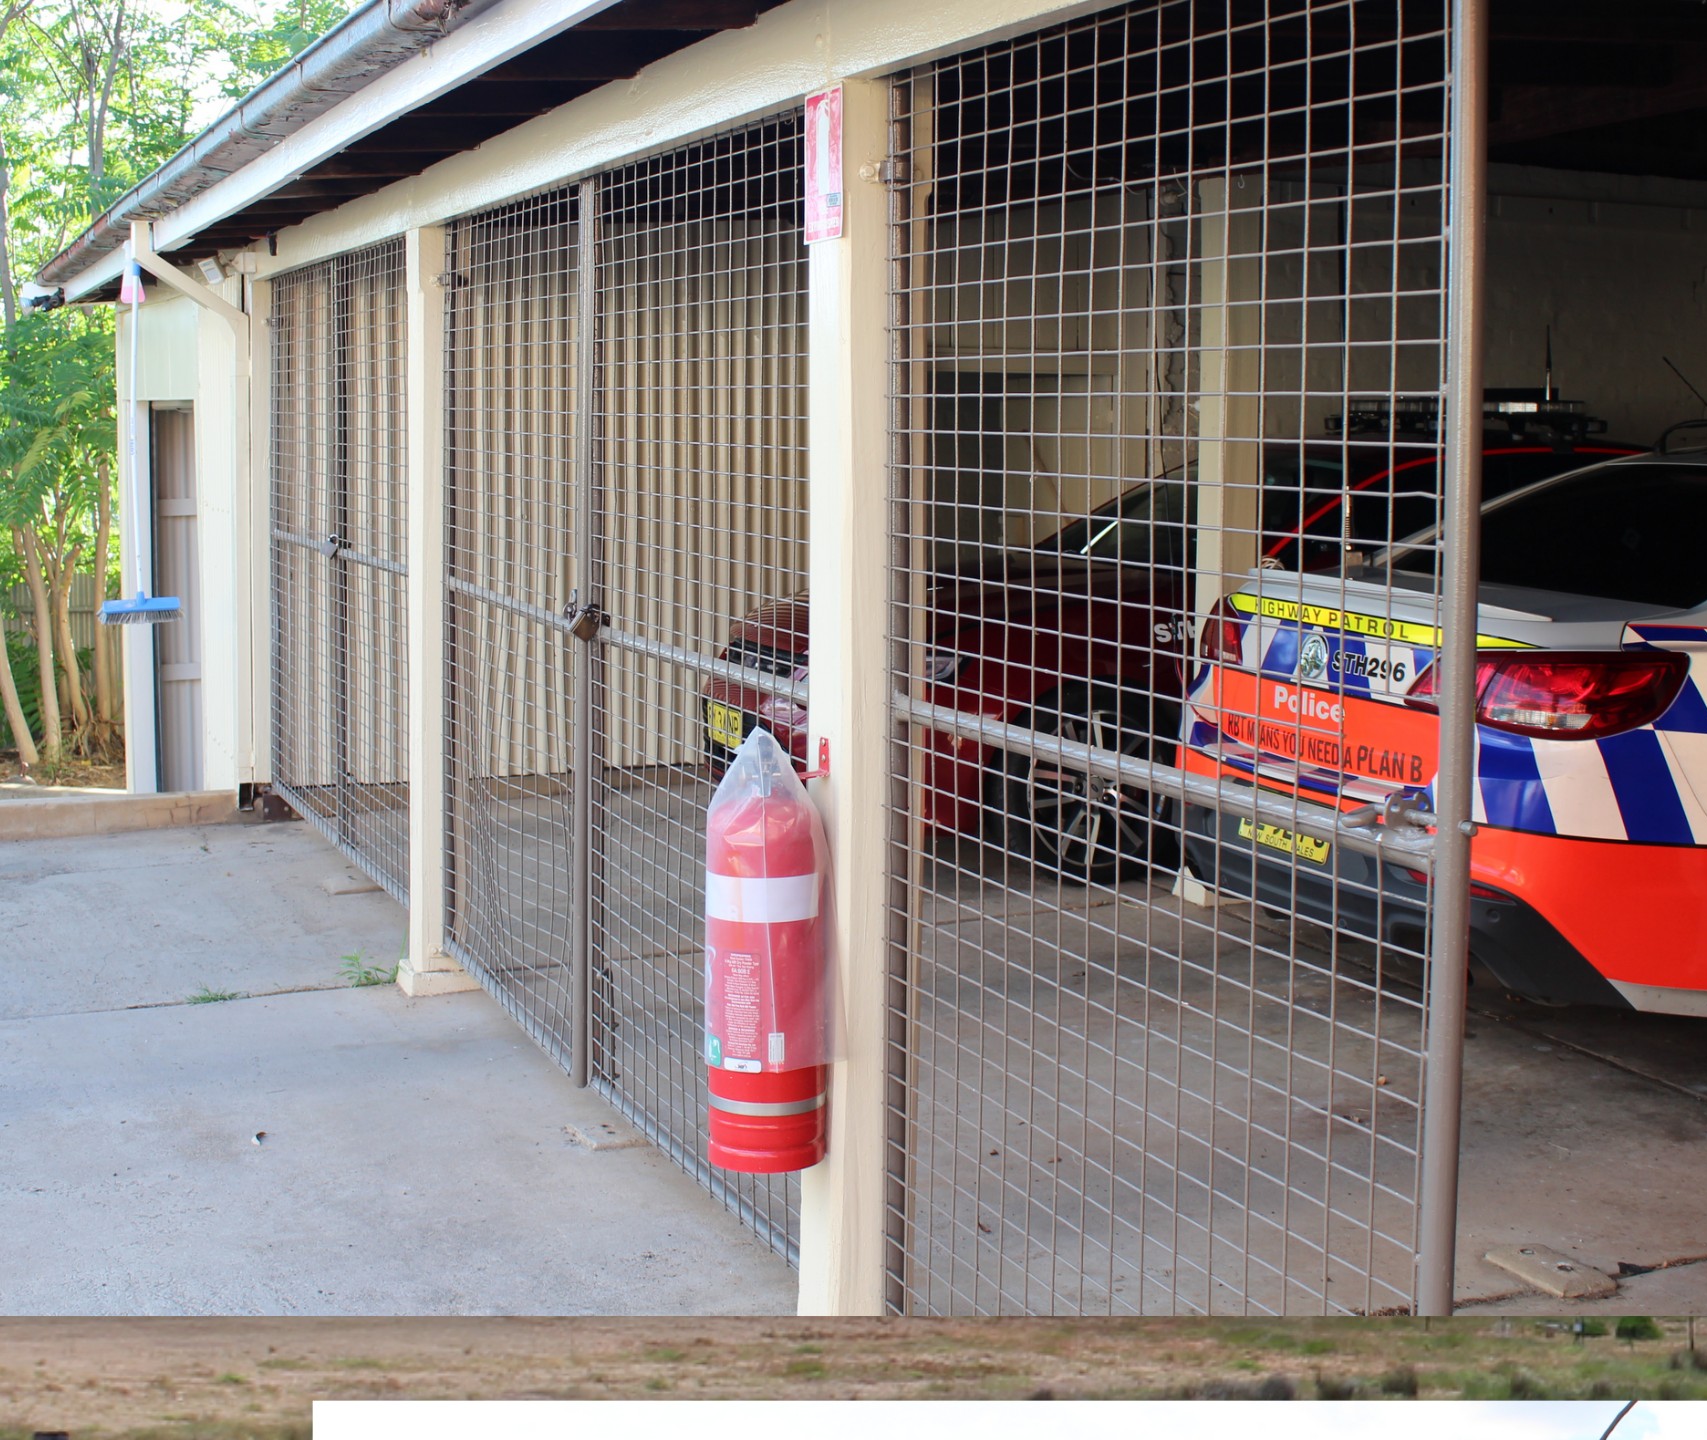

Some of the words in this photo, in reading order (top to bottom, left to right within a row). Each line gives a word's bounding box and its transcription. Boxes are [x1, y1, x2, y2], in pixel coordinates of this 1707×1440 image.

[1328, 612, 1409, 639] PATROL
[1332, 650, 1406, 682] STH296
[1274, 685, 1346, 723] Police
[1227, 712, 1247, 739] RBT
[1247, 719, 1280, 750] MANS
[1282, 729, 1305, 756] YOU
[1307, 738, 1341, 767] NEED
[1356, 745, 1405, 780] PLAN
[1410, 755, 1423, 783] B
[1248, 828, 1263, 841] NW
[1264, 834, 1288, 849] SOUTH
[1290, 842, 1315, 858] ALES
